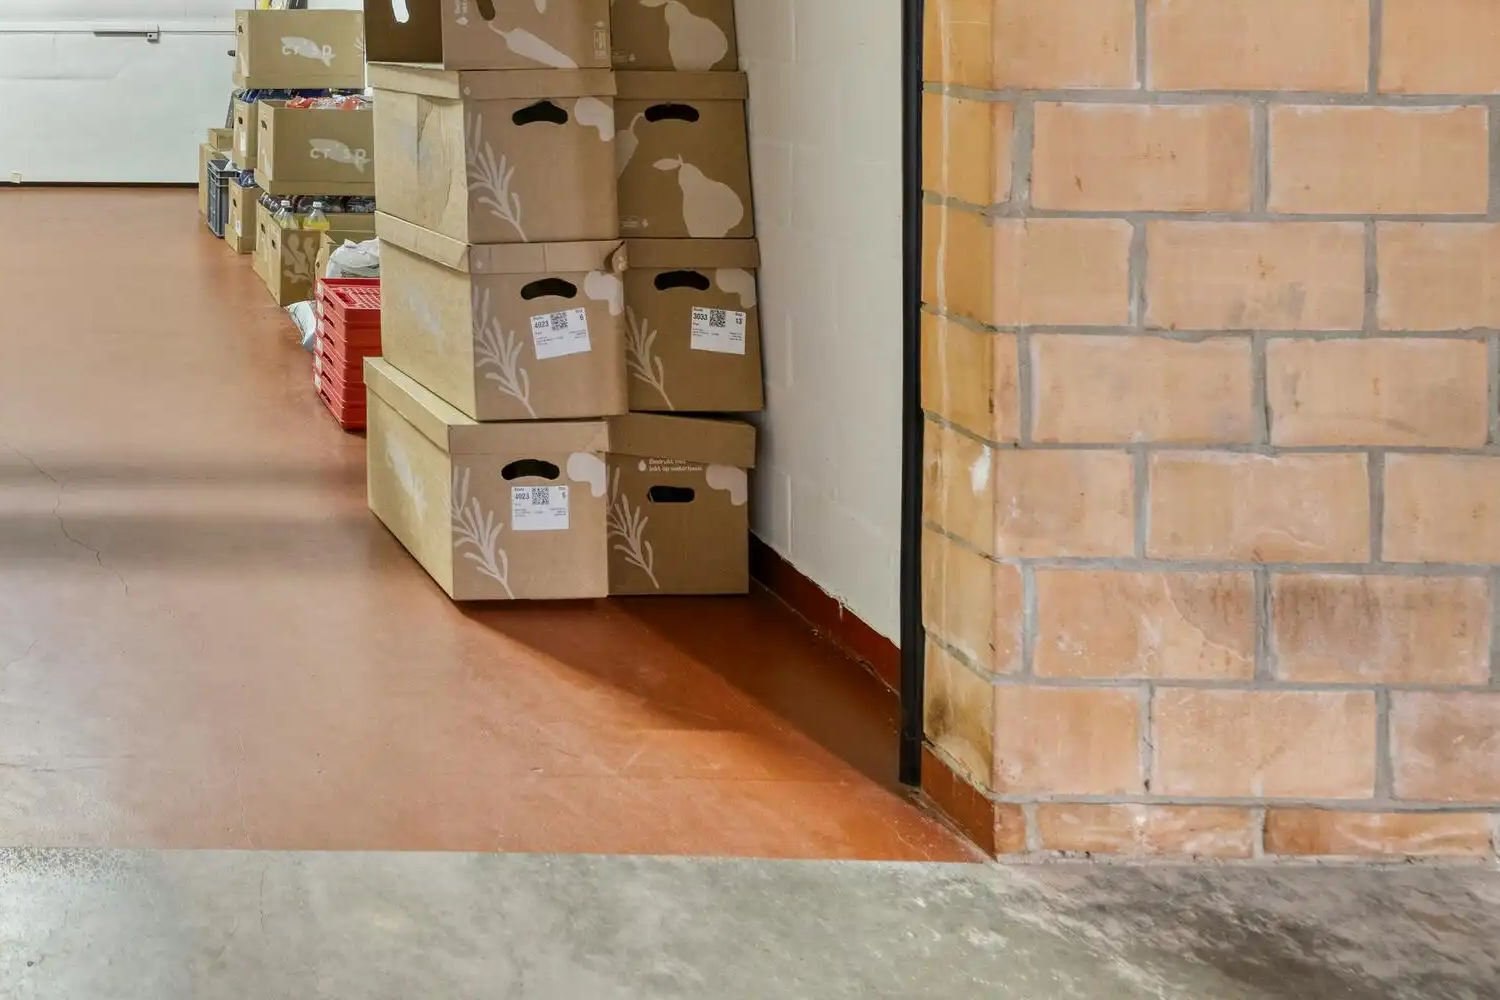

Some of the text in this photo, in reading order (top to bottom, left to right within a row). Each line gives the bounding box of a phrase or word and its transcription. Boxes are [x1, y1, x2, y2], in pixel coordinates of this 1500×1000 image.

[579, 313, 584, 321] 6
[693, 312, 708, 320] 3033
[534, 320, 549, 329] 4023
[515, 492, 530, 500] 4023
